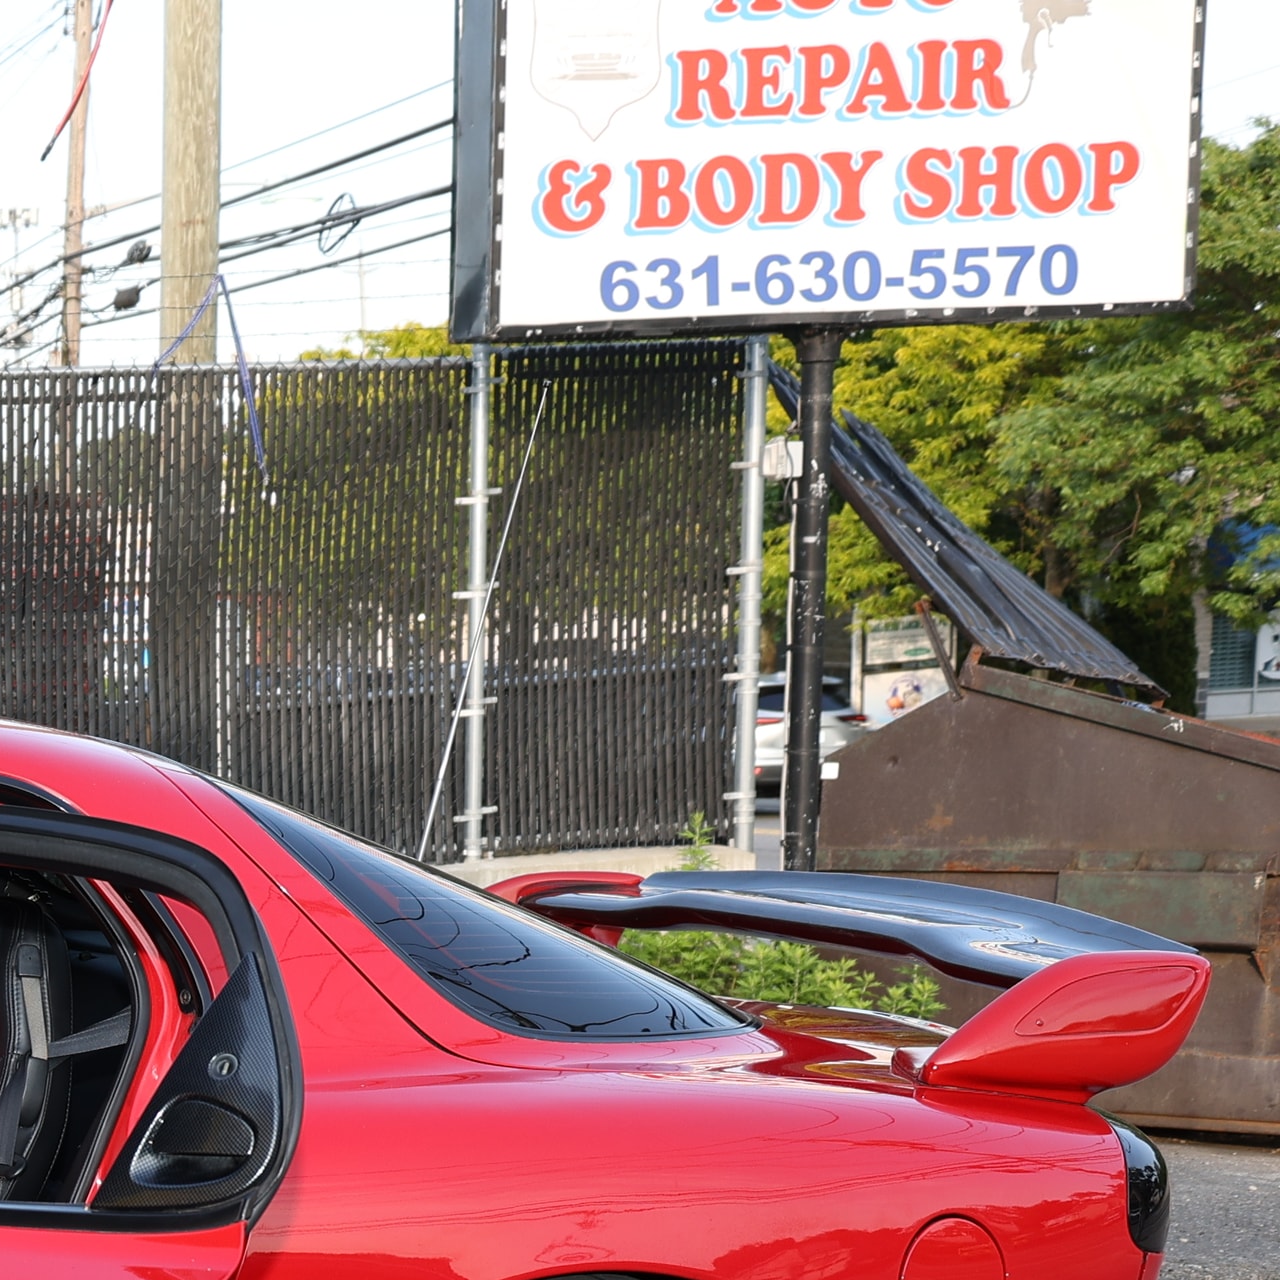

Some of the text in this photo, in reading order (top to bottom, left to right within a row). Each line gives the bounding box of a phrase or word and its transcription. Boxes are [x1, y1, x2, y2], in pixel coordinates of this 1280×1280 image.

[668, 38, 1011, 125] REPAIR
[536, 140, 1140, 235] & BODY SHOP
[599, 243, 1079, 312] 631-630-5570
